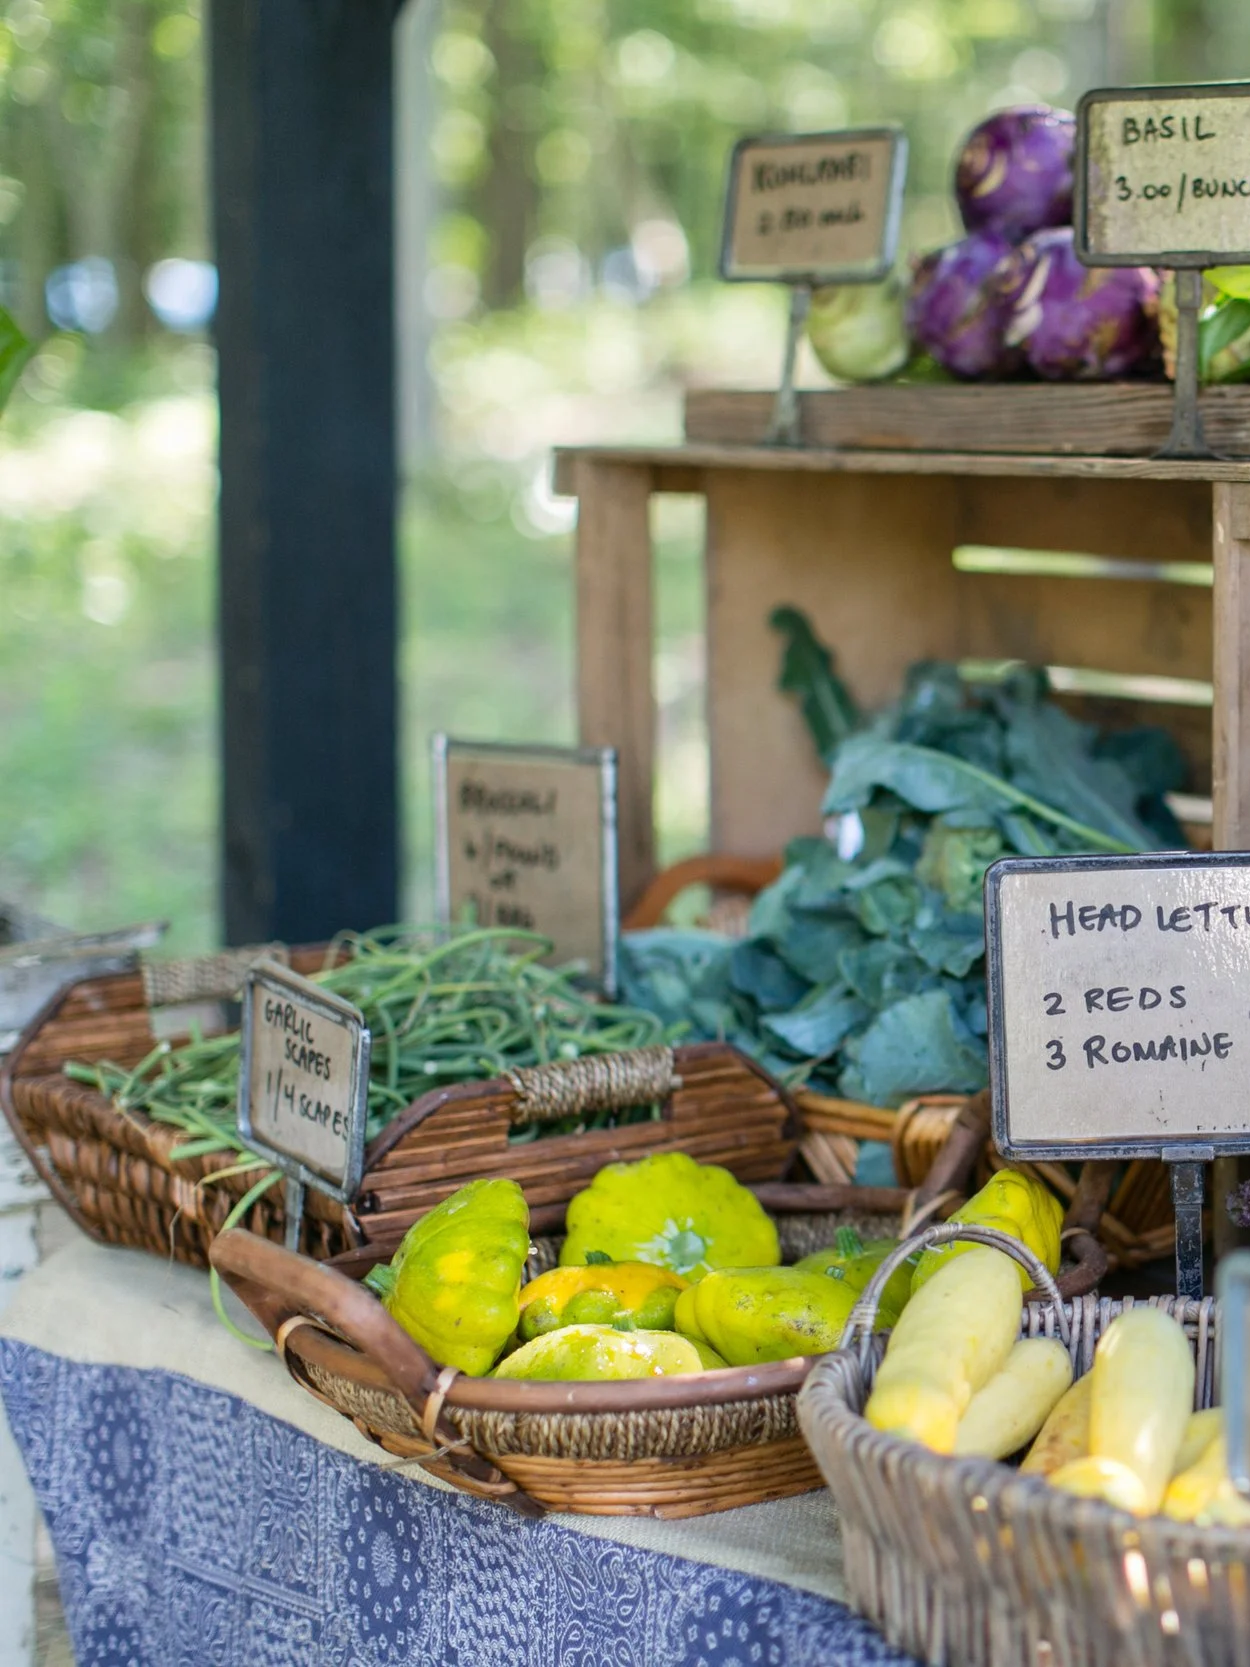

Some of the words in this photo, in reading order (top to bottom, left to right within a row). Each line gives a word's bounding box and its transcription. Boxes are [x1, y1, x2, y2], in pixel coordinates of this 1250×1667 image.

[1122, 115, 1217, 146] BASIL
[1049, 900, 1142, 939] HEAD
[1043, 992, 1066, 1015] 2
[1083, 985, 1188, 1014] REDS
[264, 1000, 315, 1045] GARLIC
[285, 1038, 332, 1081] SCAPES
[1045, 1040, 1067, 1070] 3
[1083, 1032, 1234, 1069] ROMAINE
[266, 1068, 296, 1122] 1/4
[299, 1093, 350, 1142] SCAPES
